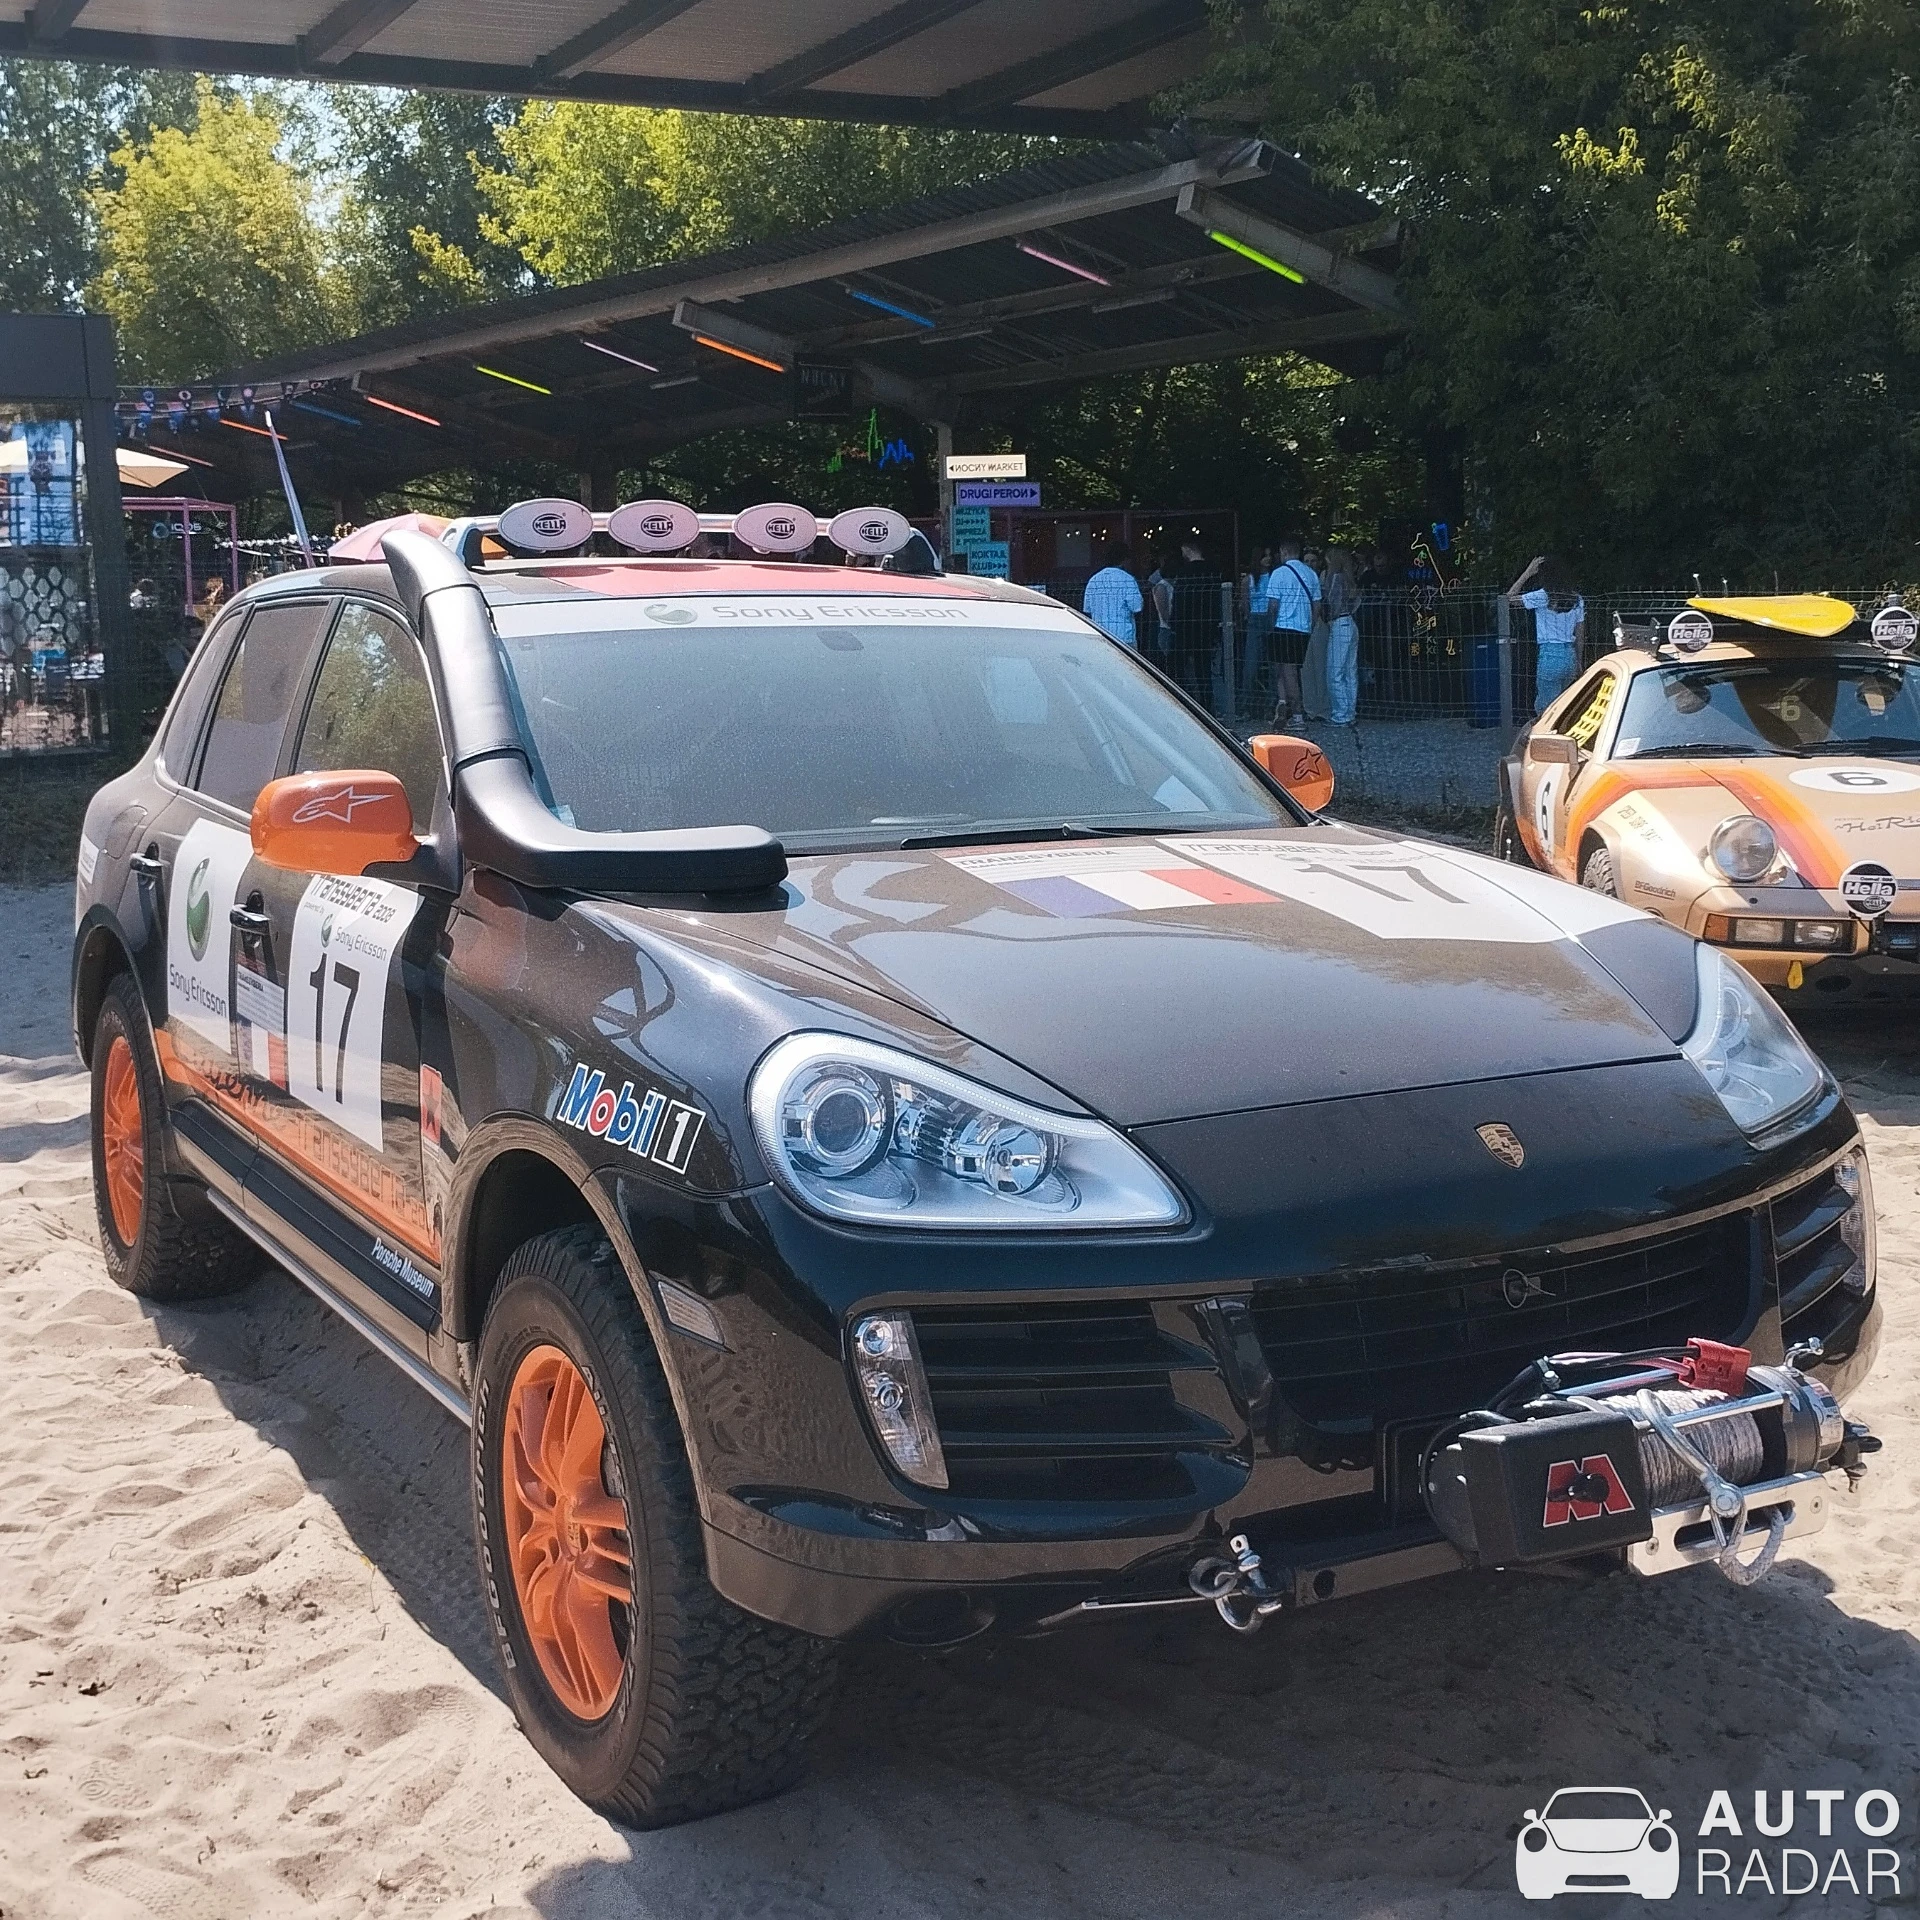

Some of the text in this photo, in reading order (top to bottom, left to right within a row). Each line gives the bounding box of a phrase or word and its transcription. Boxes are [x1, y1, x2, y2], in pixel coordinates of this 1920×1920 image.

[960, 489, 992, 499] DRUGI
[535, 520, 567, 530] HELLA
[642, 521, 674, 531] HELLA
[767, 524, 796, 534] HELLA
[862, 527, 889, 537] HELLA
[712, 605, 970, 621] Sony Ericsson
[1672, 629, 1710, 639] Hella
[1876, 625, 1914, 635] Hella
[1781, 695, 1800, 721] 6
[1827, 771, 1888, 786] 6
[1541, 781, 1551, 840] 6
[1294, 863, 1470, 904] 17
[1634, 880, 1677, 898] BFGoodrich
[1844, 882, 1893, 896] Hella
[335, 926, 388, 962] Sony Ericsson
[169, 963, 190, 1002] Sony
[190, 976, 227, 1018] Ericsson
[309, 952, 361, 1104] 17
[556, 1062, 667, 1158] Mobil
[371, 1236, 435, 1298] Porsche Museum
[474, 1378, 517, 1669] BFGoodrich
